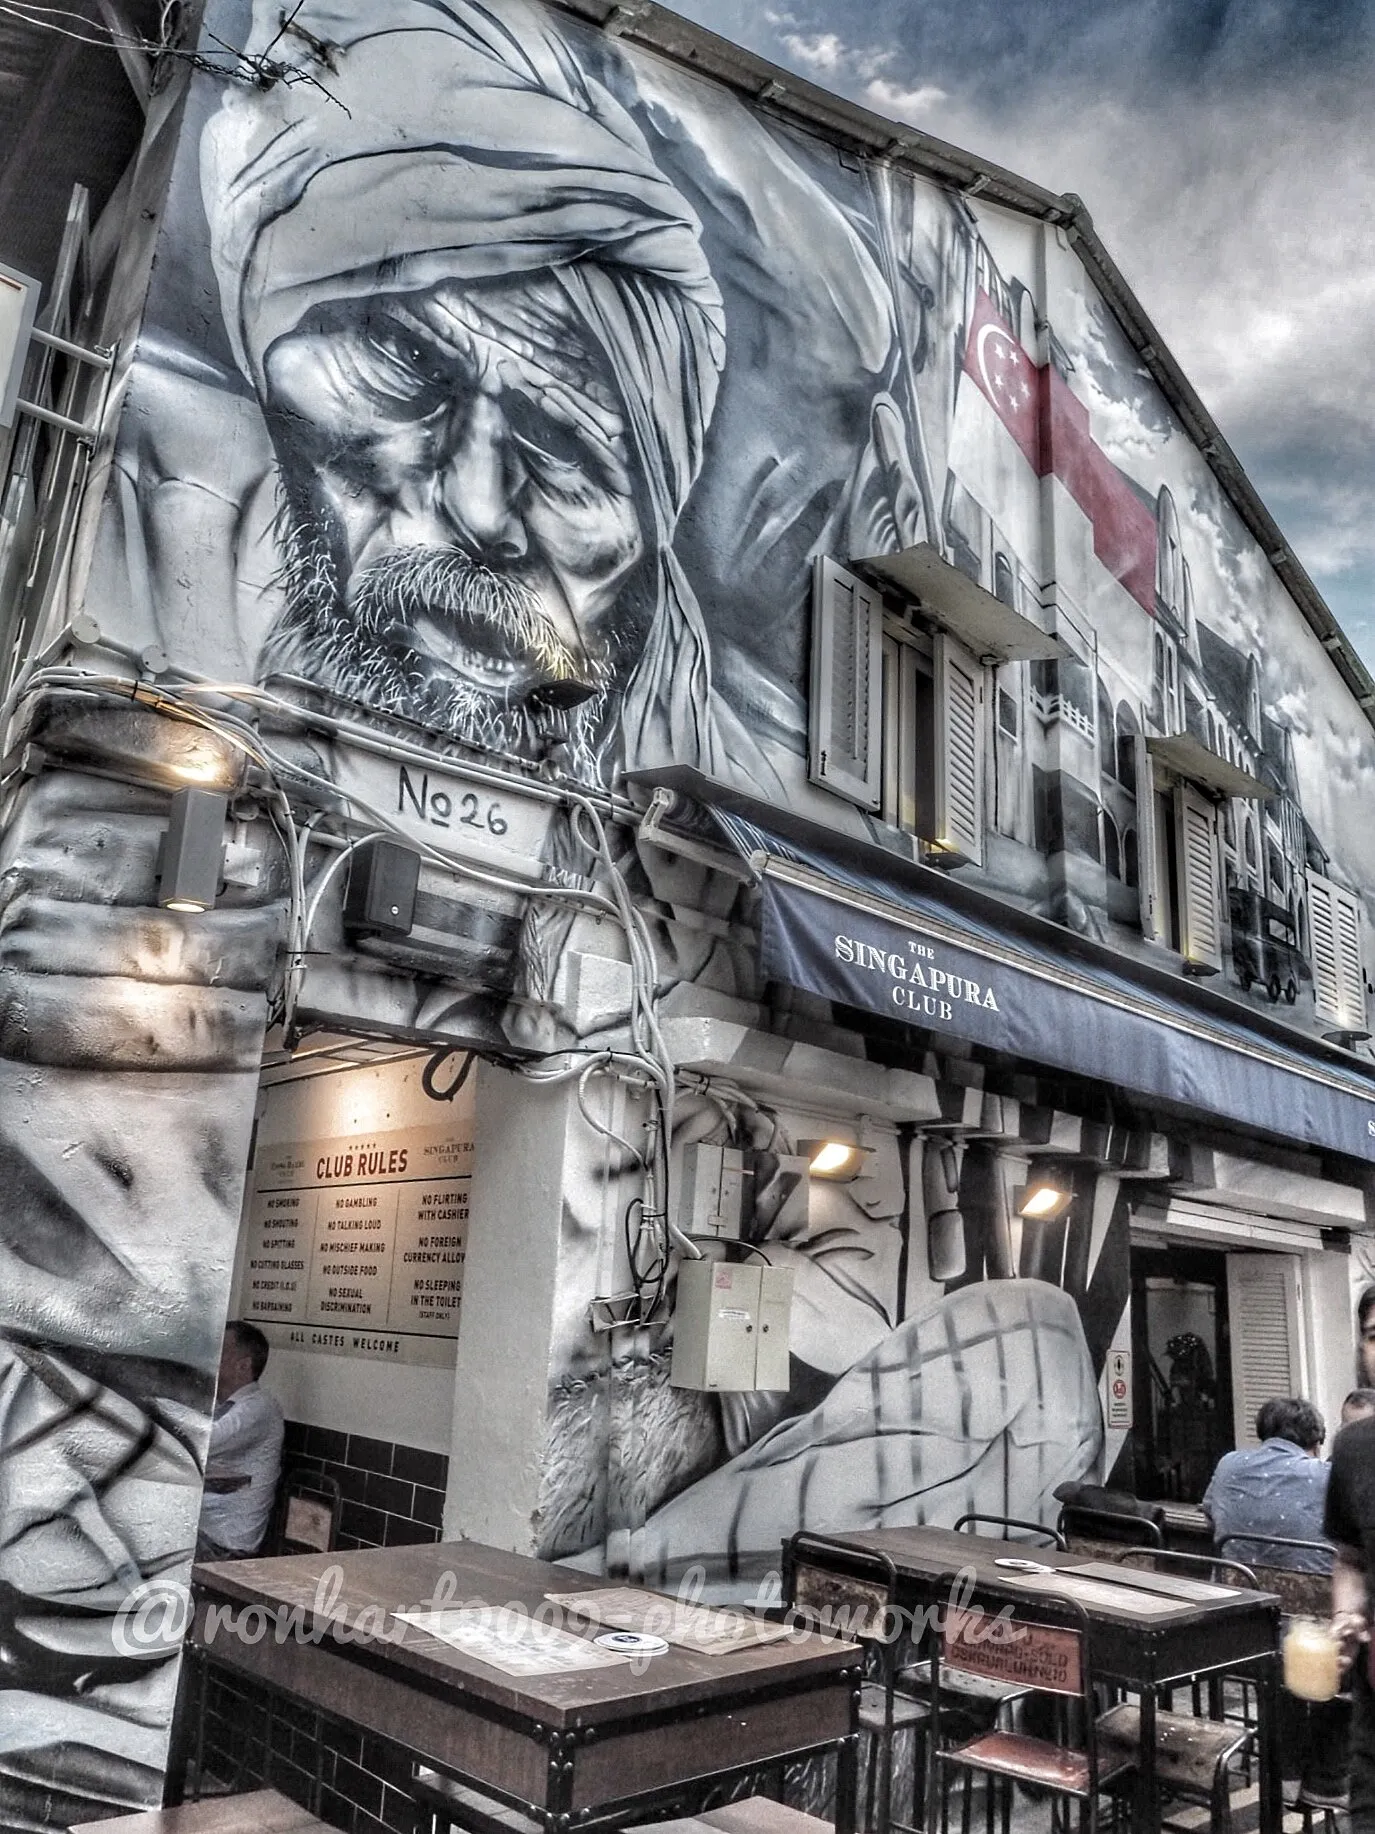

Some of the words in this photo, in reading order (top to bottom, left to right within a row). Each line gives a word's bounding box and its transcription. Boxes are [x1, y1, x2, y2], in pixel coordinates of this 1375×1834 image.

[460, 793, 508, 835] 26
[908, 941, 935, 960] THE
[834, 935, 1000, 1012] SINGAPURA
[892, 985, 953, 1021] CLUB
[316, 1154, 353, 1179] CLUB
[357, 1148, 408, 1176] RULES
[267, 1199, 274, 1208] NO
[336, 1199, 343, 1208] NO
[345, 1197, 378, 1208] GAMBLING
[422, 1194, 432, 1205] NO
[433, 1193, 468, 1205] FLIRTING
[418, 1209, 436, 1220] WITH
[437, 1208, 469, 1220] CASHIER
[264, 1219, 271, 1228] NO
[327, 1221, 336, 1230] NO
[338, 1220, 363, 1230] TALKING
[364, 1219, 382, 1230] LOUD
[263, 1240, 270, 1249] NO
[320, 1243, 329, 1252] NO
[330, 1243, 358, 1252] MISCHIEF
[360, 1243, 386, 1253] MAKING
[419, 1237, 429, 1247] NO
[430, 1236, 462, 1248] FOREIGN
[403, 1252, 441, 1263] CURRENCY
[250, 1260, 257, 1269] NO
[323, 1265, 331, 1275] NO
[332, 1265, 359, 1275] OUTSIDE
[360, 1266, 378, 1276] FOOD
[414, 1279, 424, 1290] NO
[425, 1280, 462, 1291] SLEEPING
[328, 1287, 337, 1298] NO
[338, 1288, 363, 1299] SEXUAL
[320, 1301, 372, 1314] DISCRIMINATION
[410, 1295, 419, 1305] IN
[420, 1295, 434, 1306] THE
[436, 1296, 462, 1308] TOILET
[290, 1331, 305, 1343] ALL
[311, 1333, 345, 1347] CASTES
[352, 1337, 400, 1353] WELCOME
